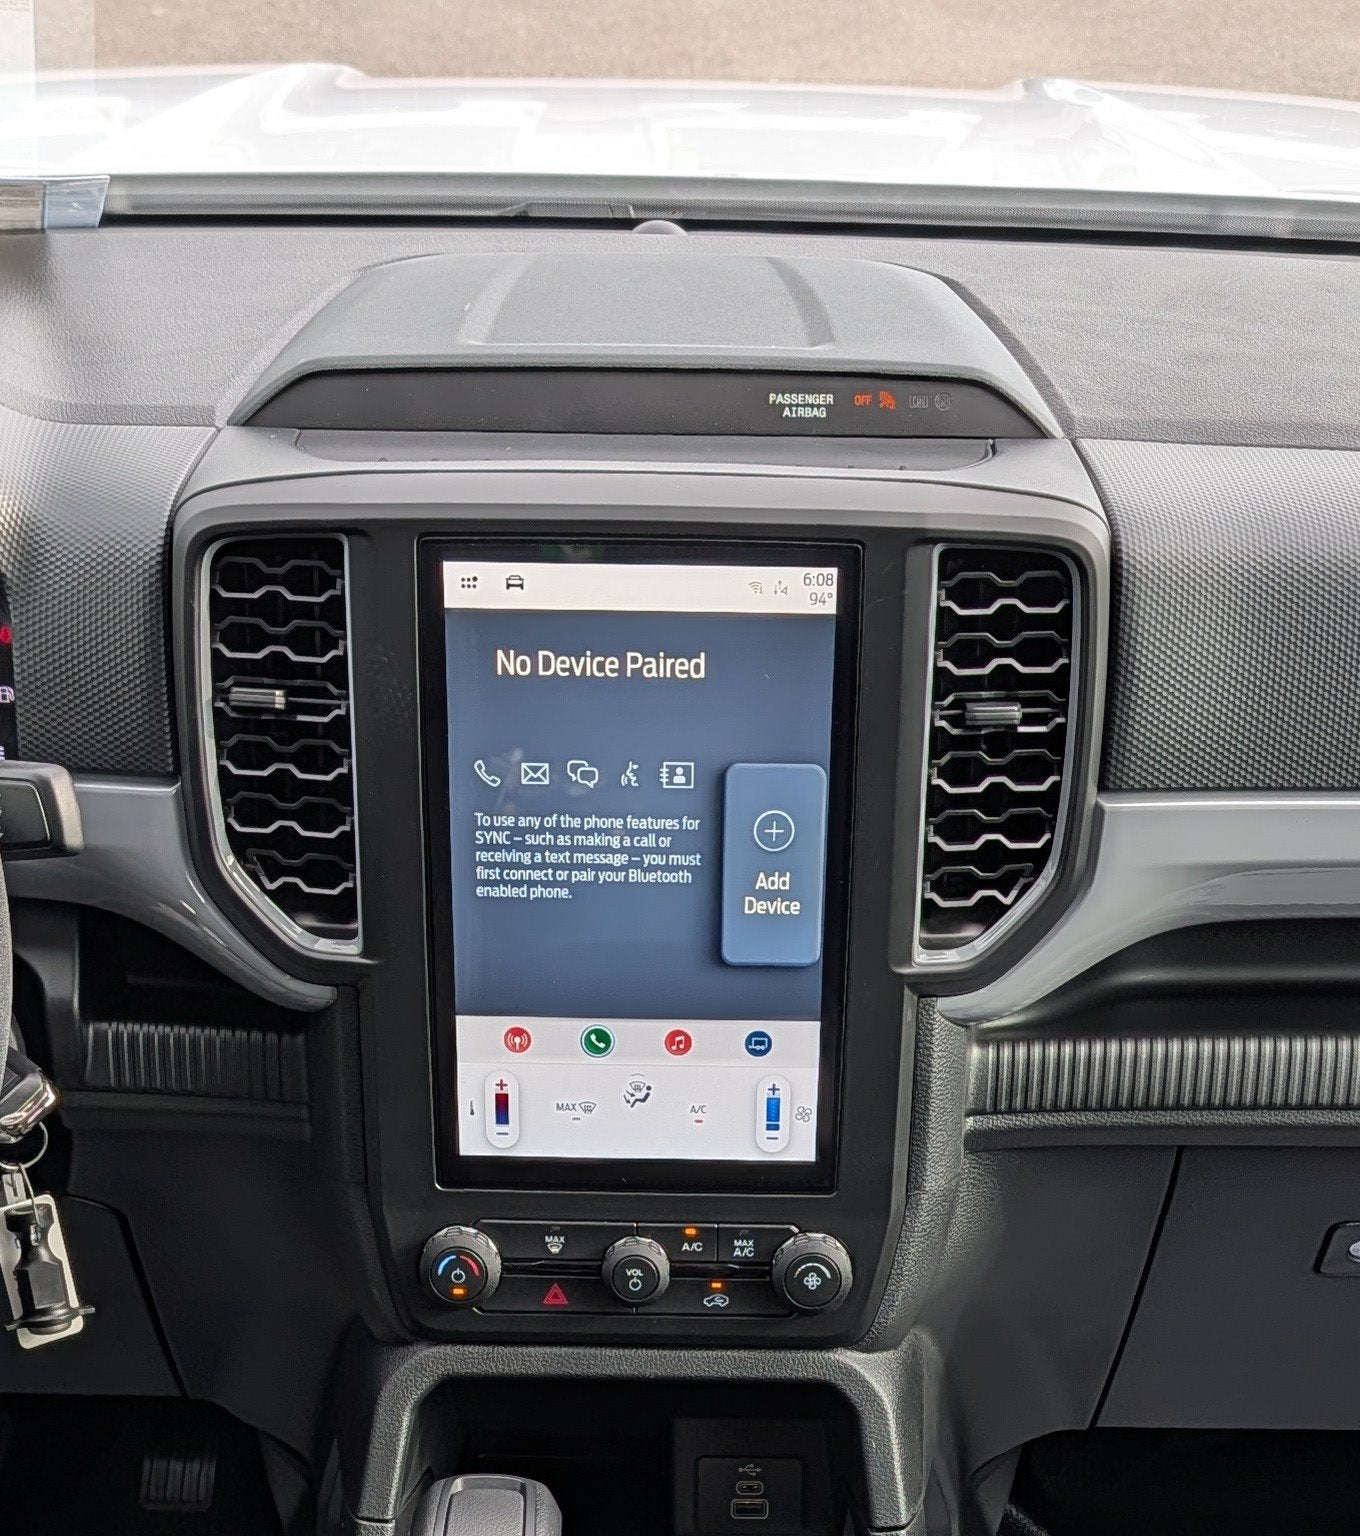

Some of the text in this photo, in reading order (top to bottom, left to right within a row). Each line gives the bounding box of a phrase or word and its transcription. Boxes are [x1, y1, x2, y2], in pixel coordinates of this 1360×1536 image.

[769, 393, 834, 405] PASSENGER
[854, 395, 872, 406] OFF
[782, 407, 827, 418] AIRBAG
[802, 573, 834, 587] 6:08
[809, 592, 834, 606] 94°
[496, 649, 707, 679] No Device Paired
[474, 812, 701, 830] To use any of the phone features for
[475, 831, 511, 845] SYNC
[524, 832, 554, 846] such
[557, 835, 571, 846] as
[574, 833, 621, 848] making
[623, 836, 631, 847] a
[634, 834, 656, 847] call
[659, 836, 672, 848] or
[476, 849, 532, 865] receiving
[534, 852, 543, 863] a
[545, 851, 570, 864] text
[573, 853, 629, 867] message
[642, 854, 666, 867] you
[669, 853, 701, 866] must
[476, 866, 692, 884] first connect or pair your Bluetooth
[755, 871, 790, 891] Add
[476, 884, 572, 900] enabled phone.
[744, 896, 801, 916] Device
[556, 1102, 576, 1112] MAX
[690, 1105, 707, 1115] A/C
[544, 1235, 565, 1243] MAX
[734, 1239, 754, 1247] MAX
[681, 1242, 703, 1252] A/C
[733, 1247, 755, 1258] A/C
[625, 1268, 644, 1277] VOL
